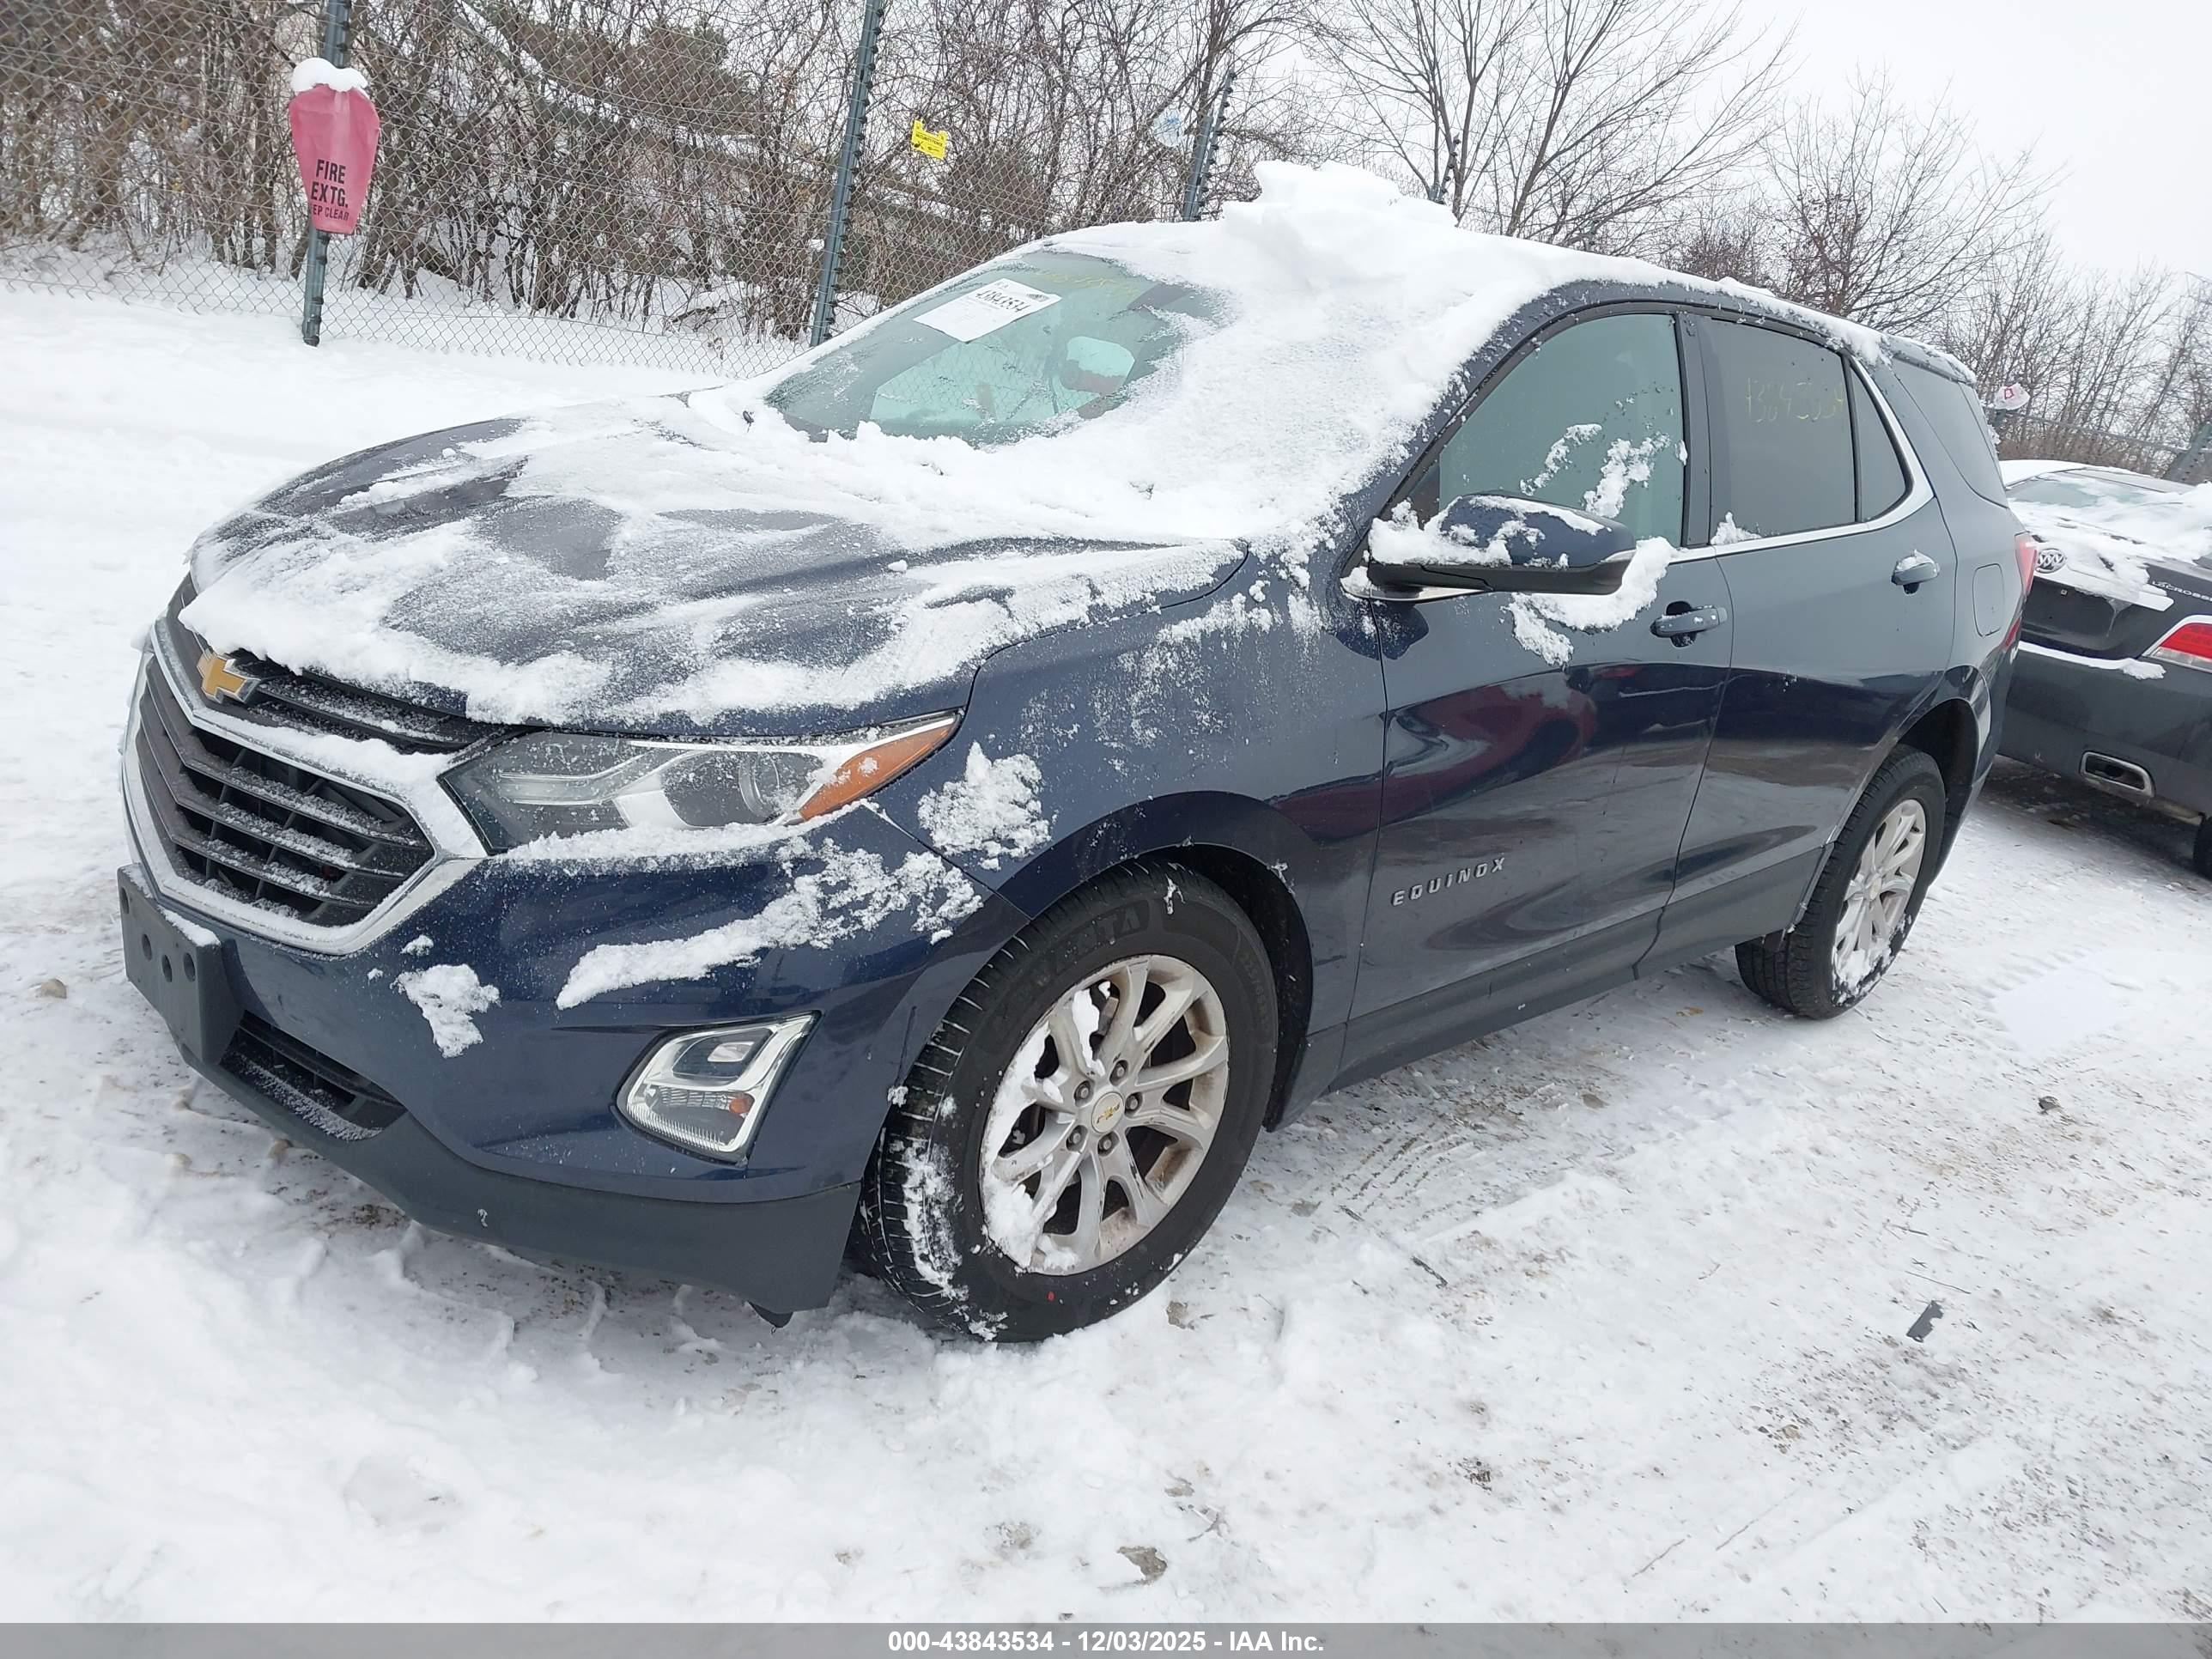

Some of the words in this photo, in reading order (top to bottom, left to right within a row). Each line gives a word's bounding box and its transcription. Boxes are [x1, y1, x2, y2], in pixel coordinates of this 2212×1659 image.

[316, 159, 346, 184] FIRE
[311, 181, 349, 208] EXTG.
[325, 207, 349, 221] CLEAR
[2152, 580, 2212, 601] LACROSS
[1390, 858, 1505, 906] EQUINOX
